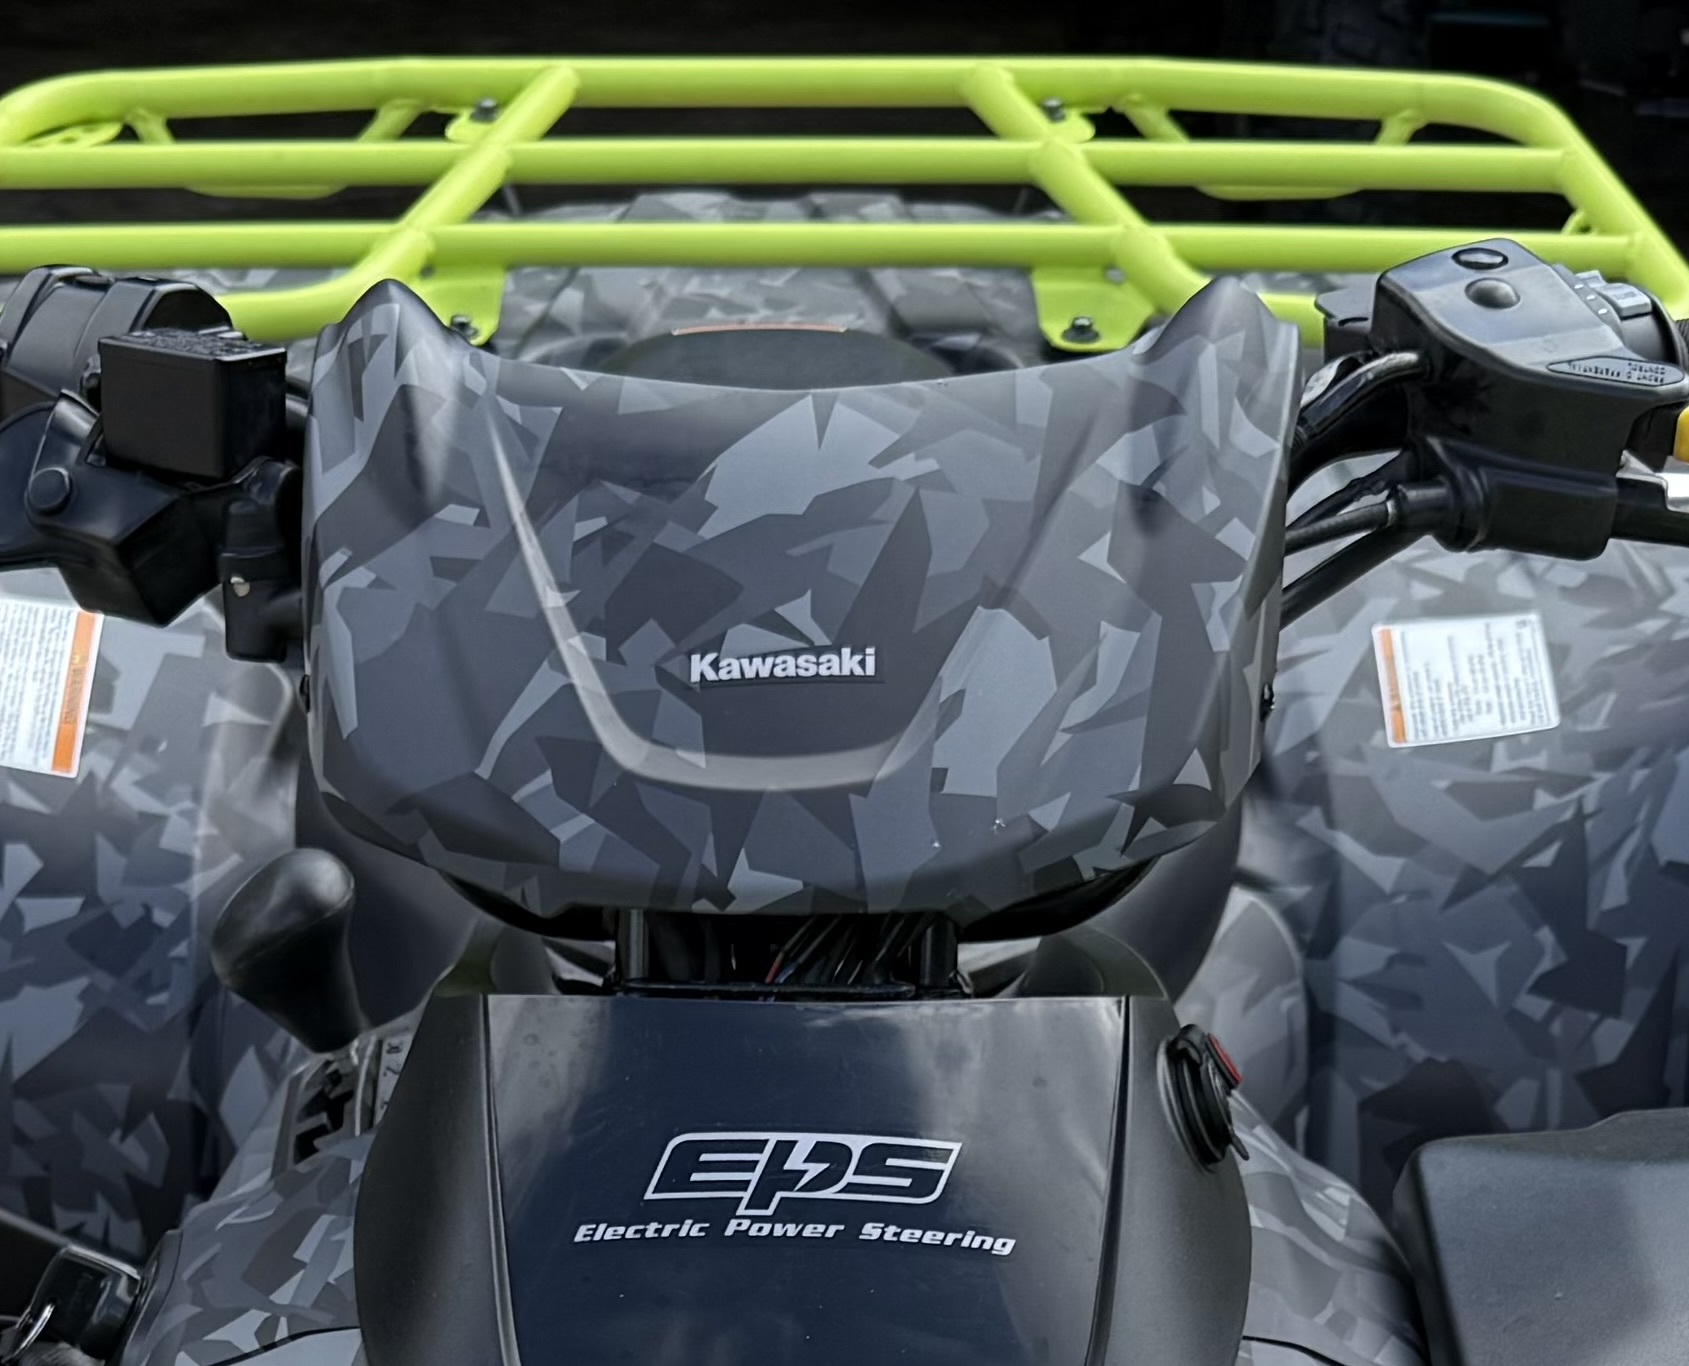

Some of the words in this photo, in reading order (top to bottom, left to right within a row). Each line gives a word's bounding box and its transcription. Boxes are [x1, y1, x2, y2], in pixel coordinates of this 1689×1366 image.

[690, 646, 876, 684] Kawasaki
[643, 1131, 963, 1217] EPS
[573, 1218, 710, 1243] Electric
[723, 1218, 845, 1239] Power
[858, 1222, 1016, 1256] Steering
